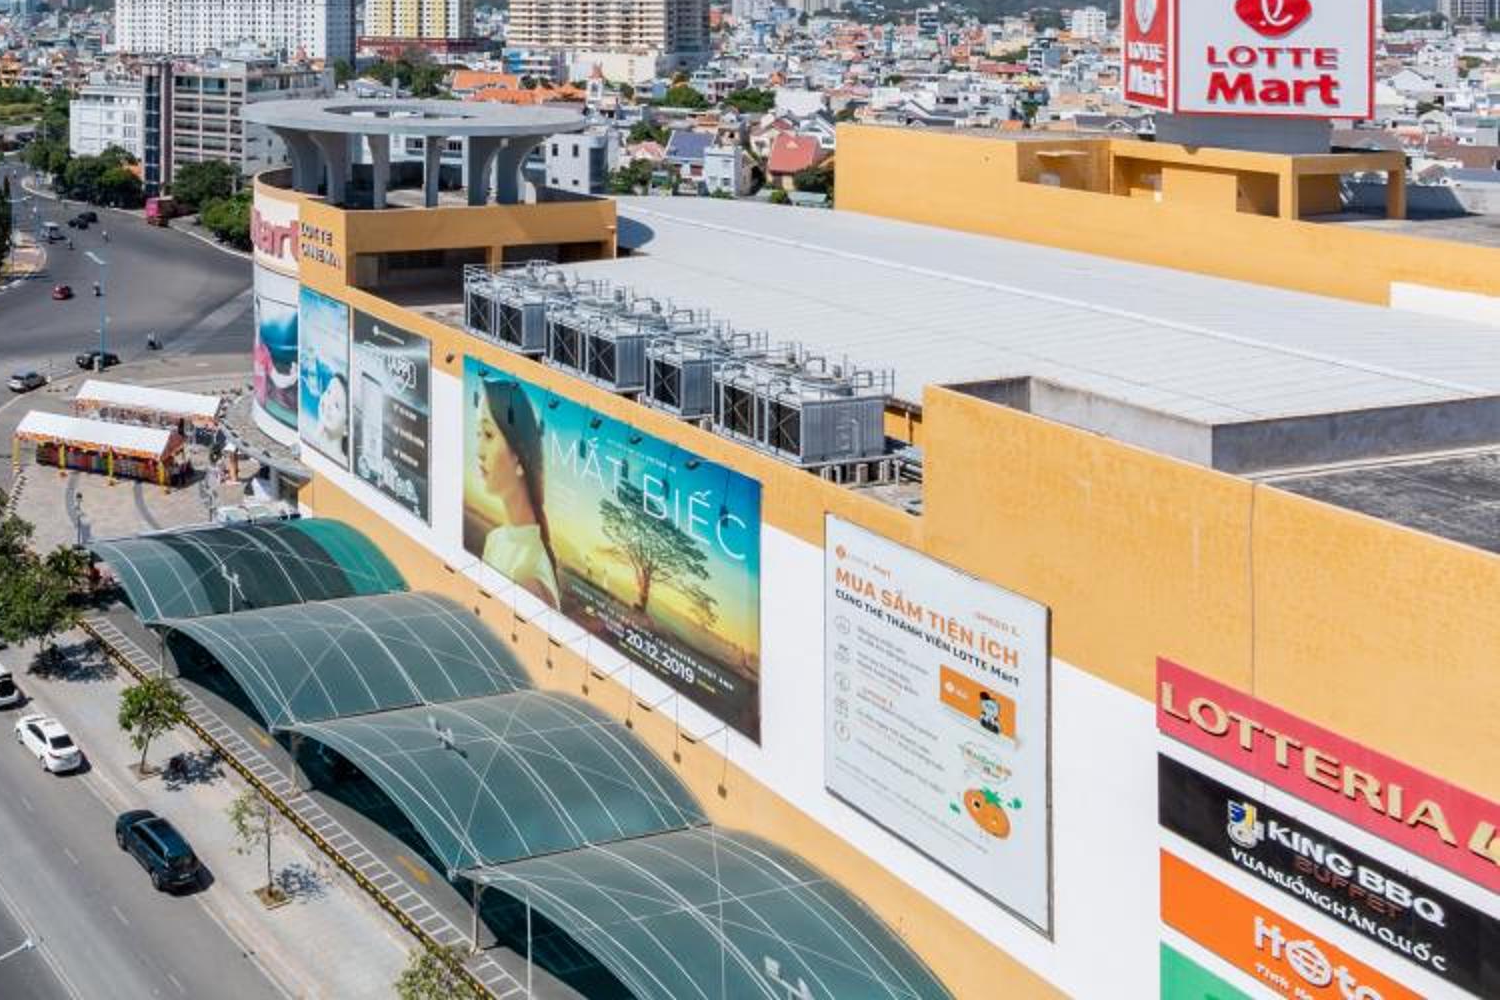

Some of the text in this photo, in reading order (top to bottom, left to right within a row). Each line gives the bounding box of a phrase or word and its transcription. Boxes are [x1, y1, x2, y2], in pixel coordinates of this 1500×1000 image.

[1206, 45, 1339, 70] LOTTE
[1206, 71, 1340, 108] Mart
[835, 567, 877, 601] MUA
[625, 628, 695, 684] 20.12.2019
[1161, 680, 1458, 849] LOTTERIA
[1268, 821, 1446, 927] KING BBQ
